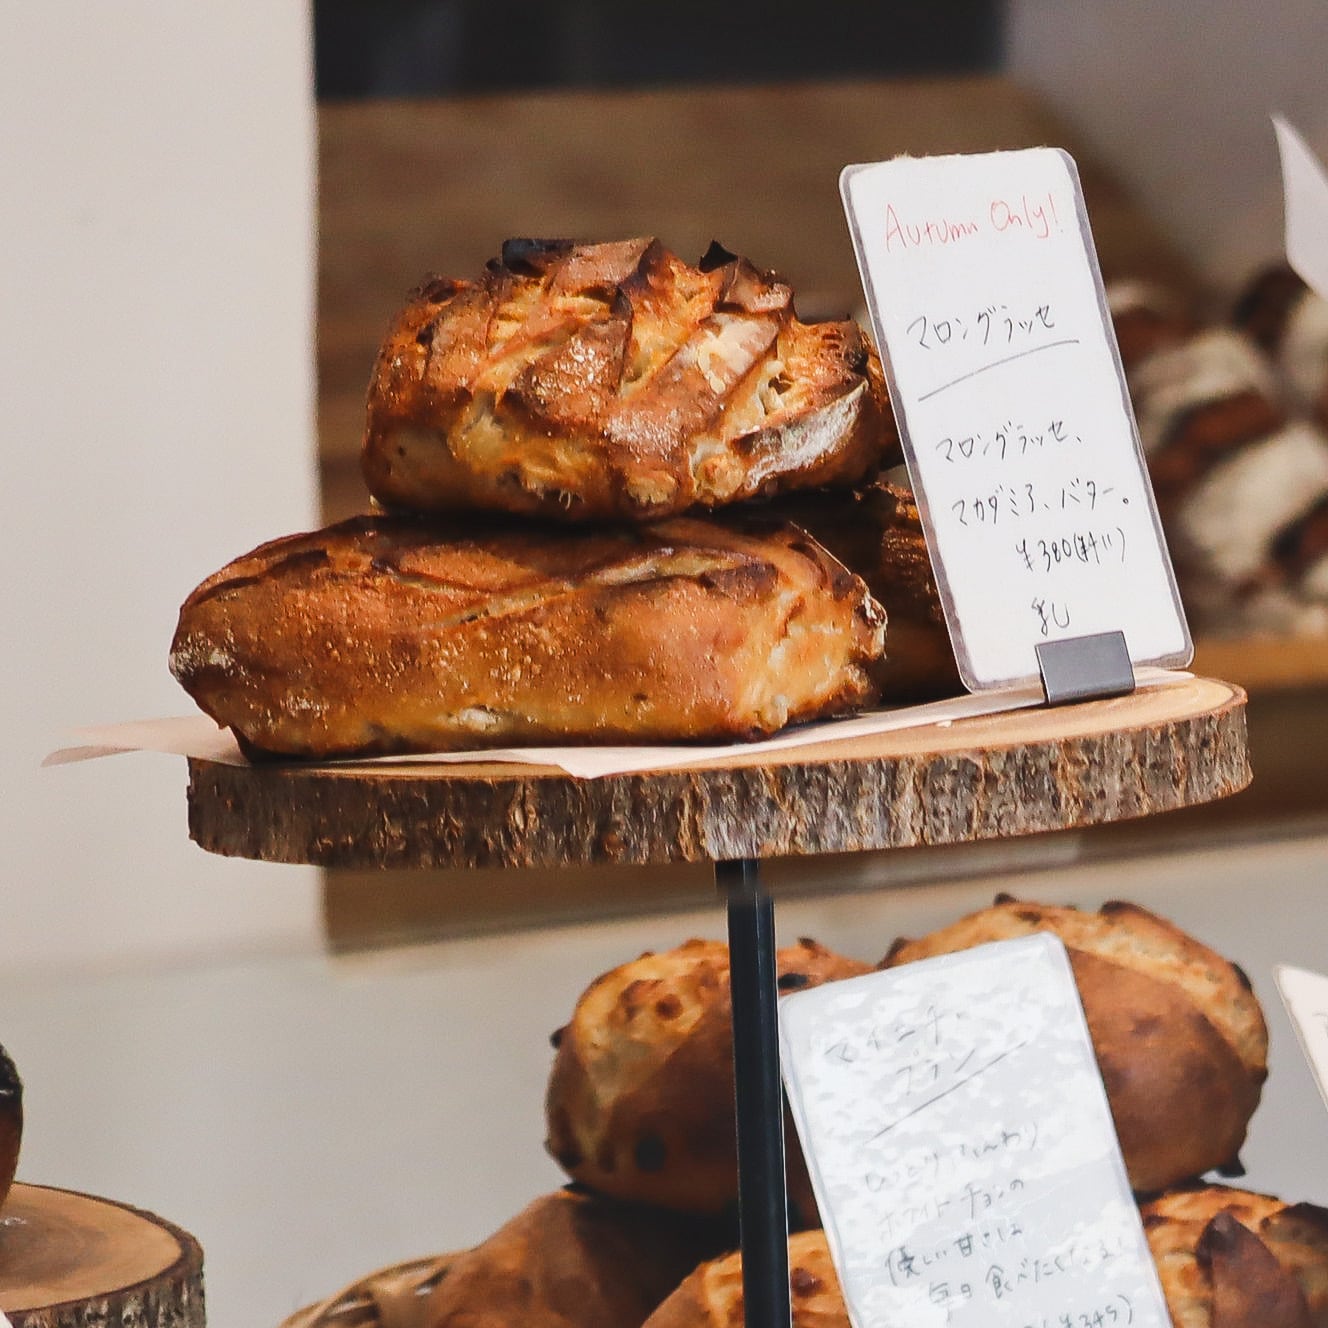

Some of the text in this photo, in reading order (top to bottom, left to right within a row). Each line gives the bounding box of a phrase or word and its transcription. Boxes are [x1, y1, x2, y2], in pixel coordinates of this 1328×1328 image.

[882, 194, 1065, 252] Autumn Only!
[906, 304, 1058, 349] マロングラッセ
